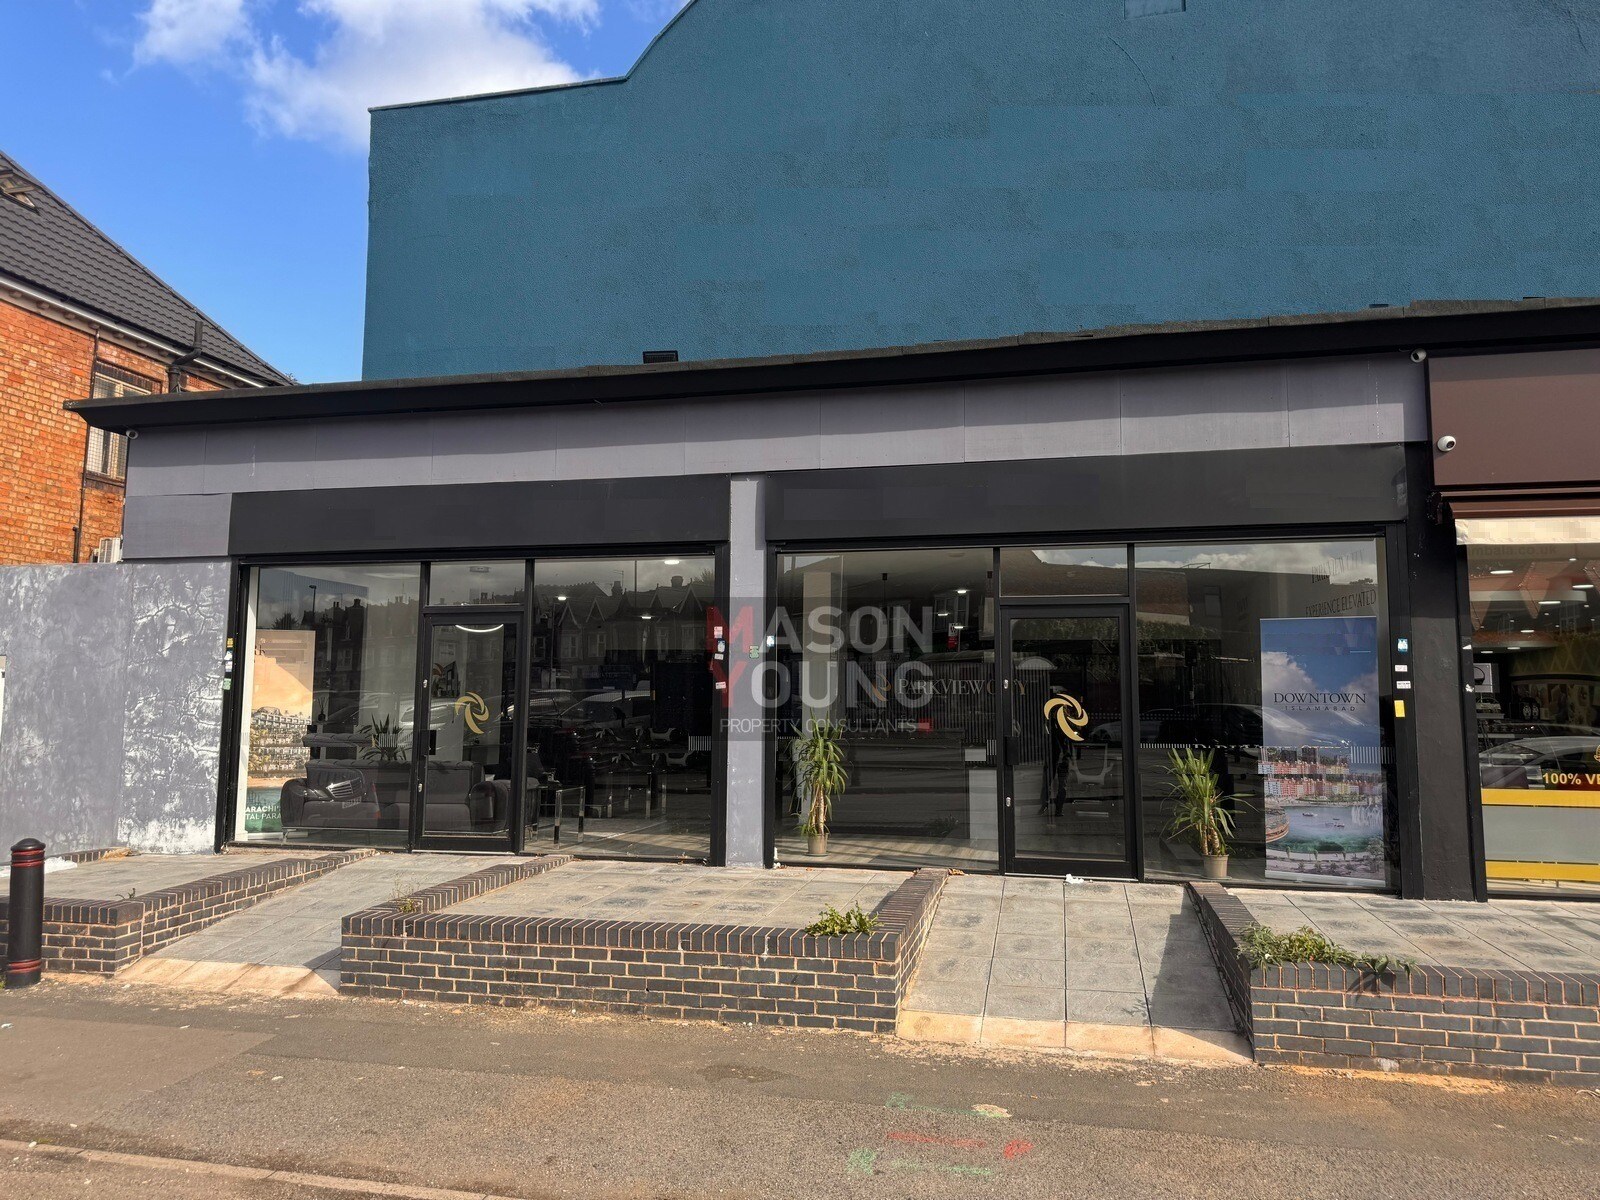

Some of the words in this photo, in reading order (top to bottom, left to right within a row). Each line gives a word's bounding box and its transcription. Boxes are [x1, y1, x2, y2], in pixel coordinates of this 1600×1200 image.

[1305, 597, 1340, 617] EXPERIENCE
[1341, 589, 1377, 611] ELEVATED
[898, 678, 985, 695] PARKVIEW
[1274, 692, 1366, 704] DOWNTOWN
[1542, 772, 1582, 785] 100%
[245, 805, 281, 813] ARACHI'
